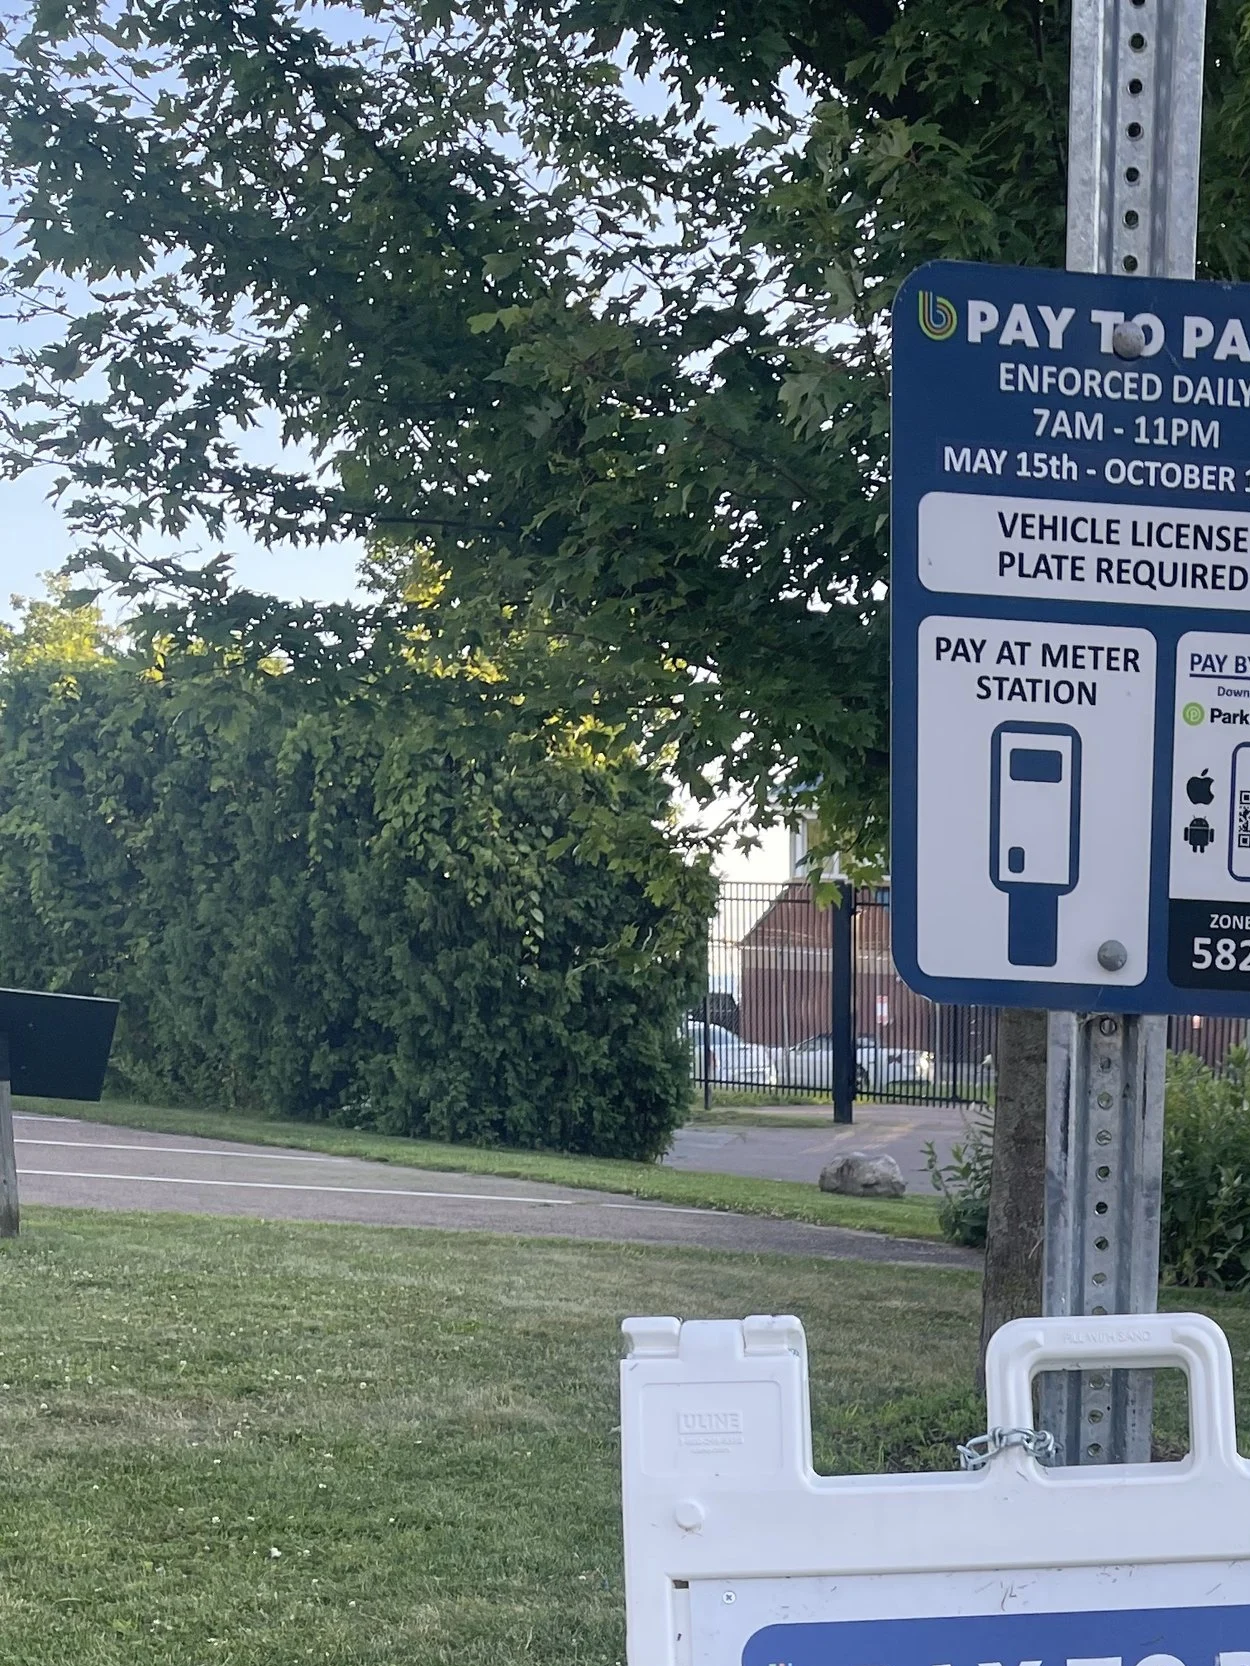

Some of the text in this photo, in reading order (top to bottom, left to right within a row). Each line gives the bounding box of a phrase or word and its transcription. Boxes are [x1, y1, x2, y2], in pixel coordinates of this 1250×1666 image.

[967, 300, 1076, 350] PAY
[1091, 309, 1165, 357] TO
[999, 362, 1163, 402] ENFORCED
[1033, 408, 1104, 442] 7AM
[1134, 415, 1220, 449] 11PM
[943, 446, 1008, 476] MAY
[1016, 451, 1078, 481] 15th
[1104, 458, 1235, 493] OCTOBER
[998, 511, 1249, 553] VEHICLE LICENSE
[998, 551, 1249, 592] PLATE REQUIRED
[935, 636, 1141, 673] PAY AT METER
[1190, 653, 1228, 673] PAY
[976, 675, 1097, 706] STATION
[683, 1413, 740, 1429] ULINE
